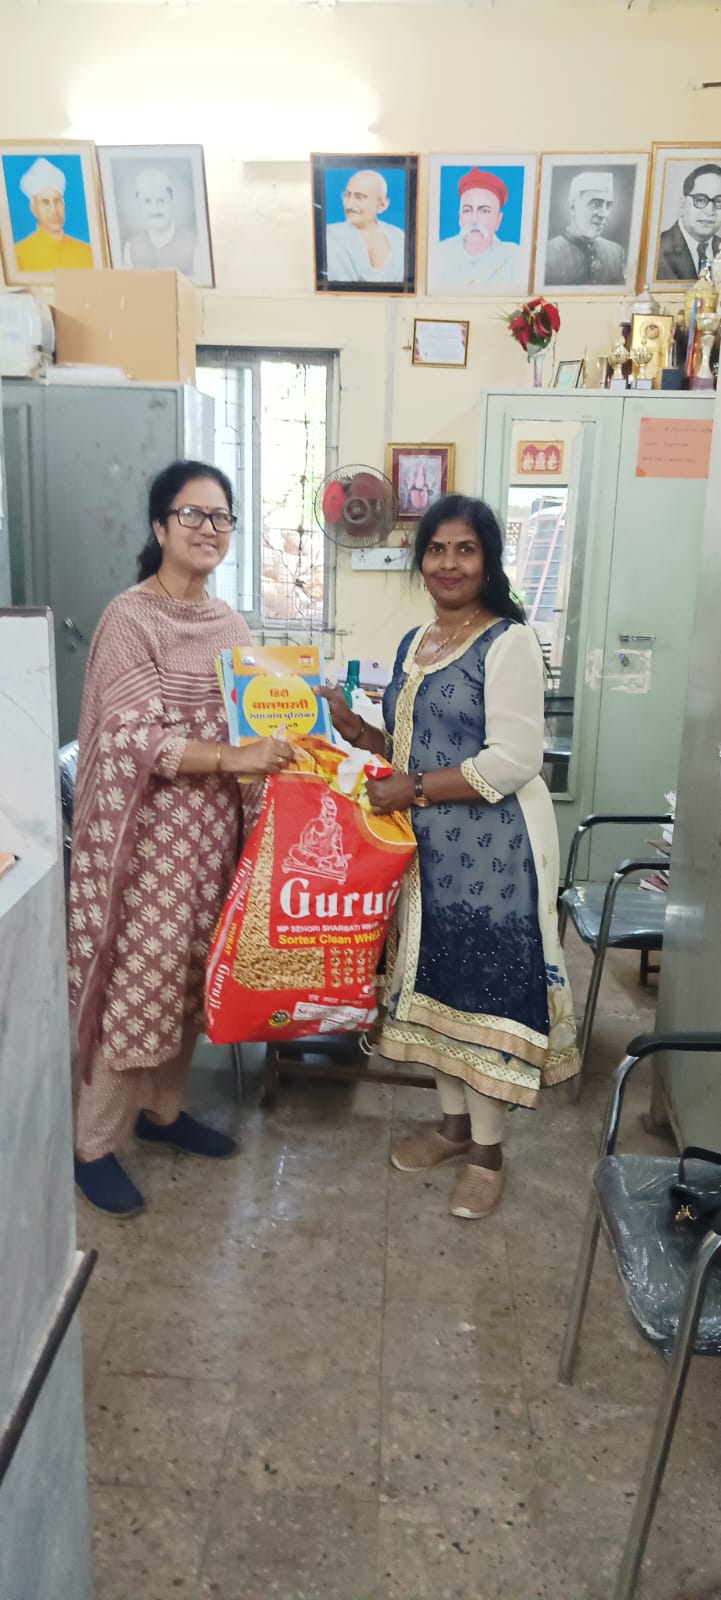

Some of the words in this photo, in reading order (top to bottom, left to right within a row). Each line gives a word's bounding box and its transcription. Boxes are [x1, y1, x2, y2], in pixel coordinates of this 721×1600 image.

[280, 877, 401, 920] Guruji
[279, 933, 316, 945] Sortex
[319, 933, 351, 945] Clean
